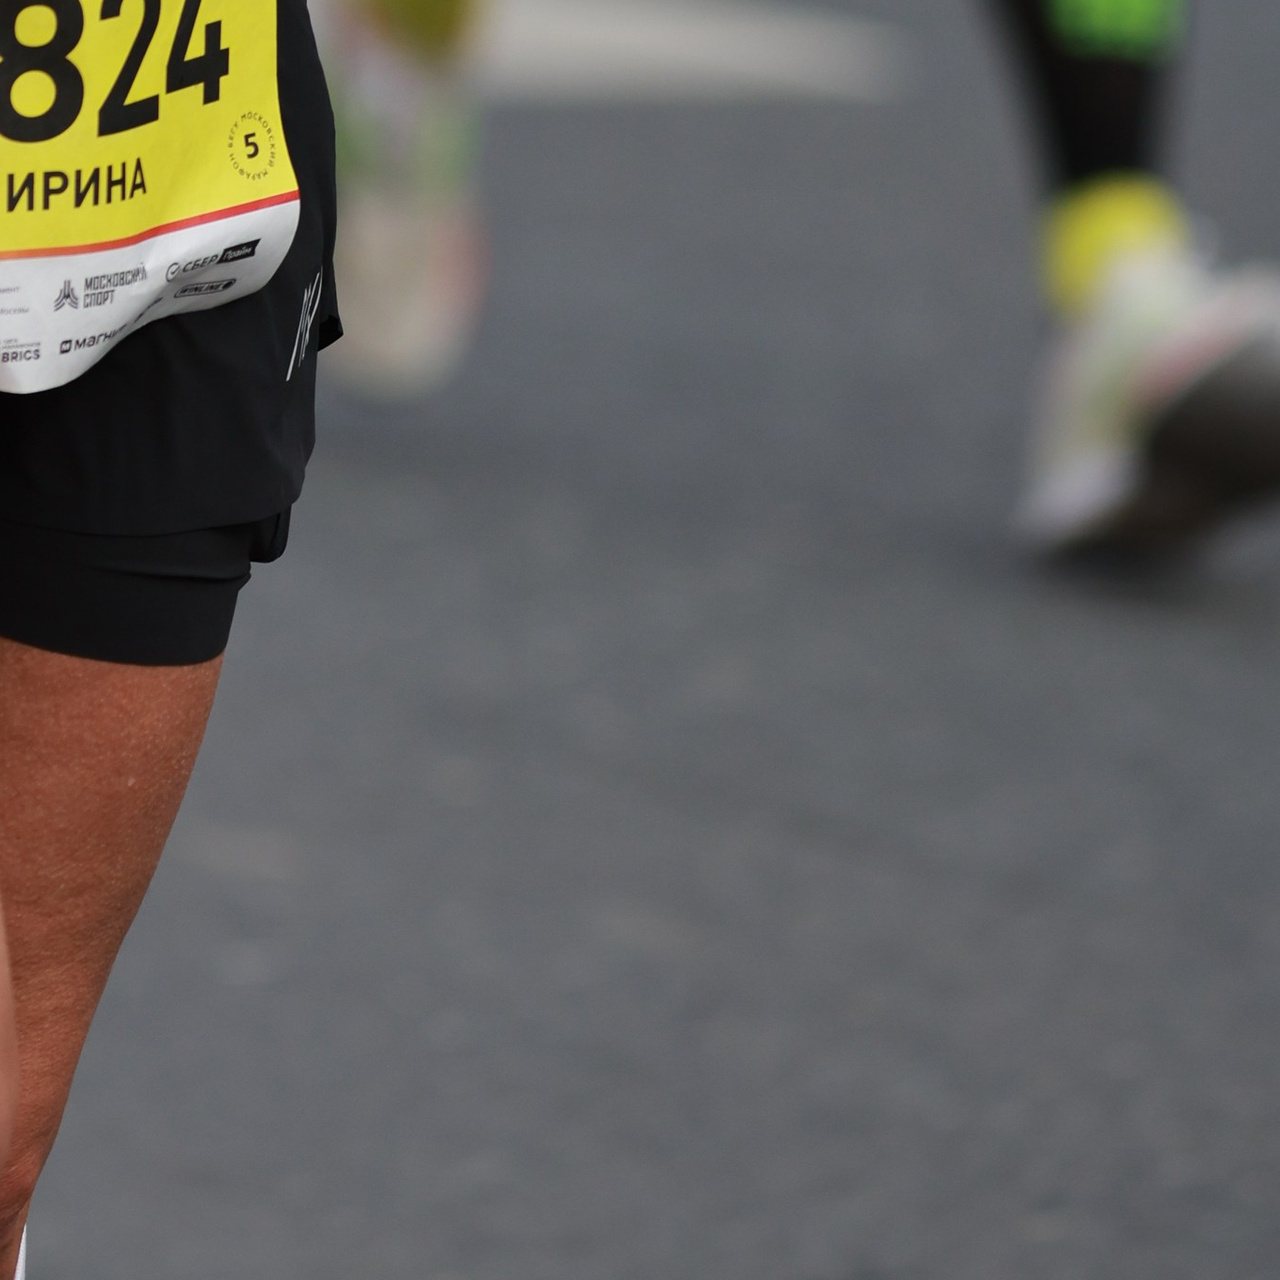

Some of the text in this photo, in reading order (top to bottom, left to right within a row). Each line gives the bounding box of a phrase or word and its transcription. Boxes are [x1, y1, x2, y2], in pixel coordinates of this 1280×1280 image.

[243, 131, 260, 160] 5
[6, 157, 147, 213] ИРИНА
[182, 254, 220, 273] СБЕР
[83, 289, 115, 309] СПОРТ
[1, 349, 41, 363] BRICS
